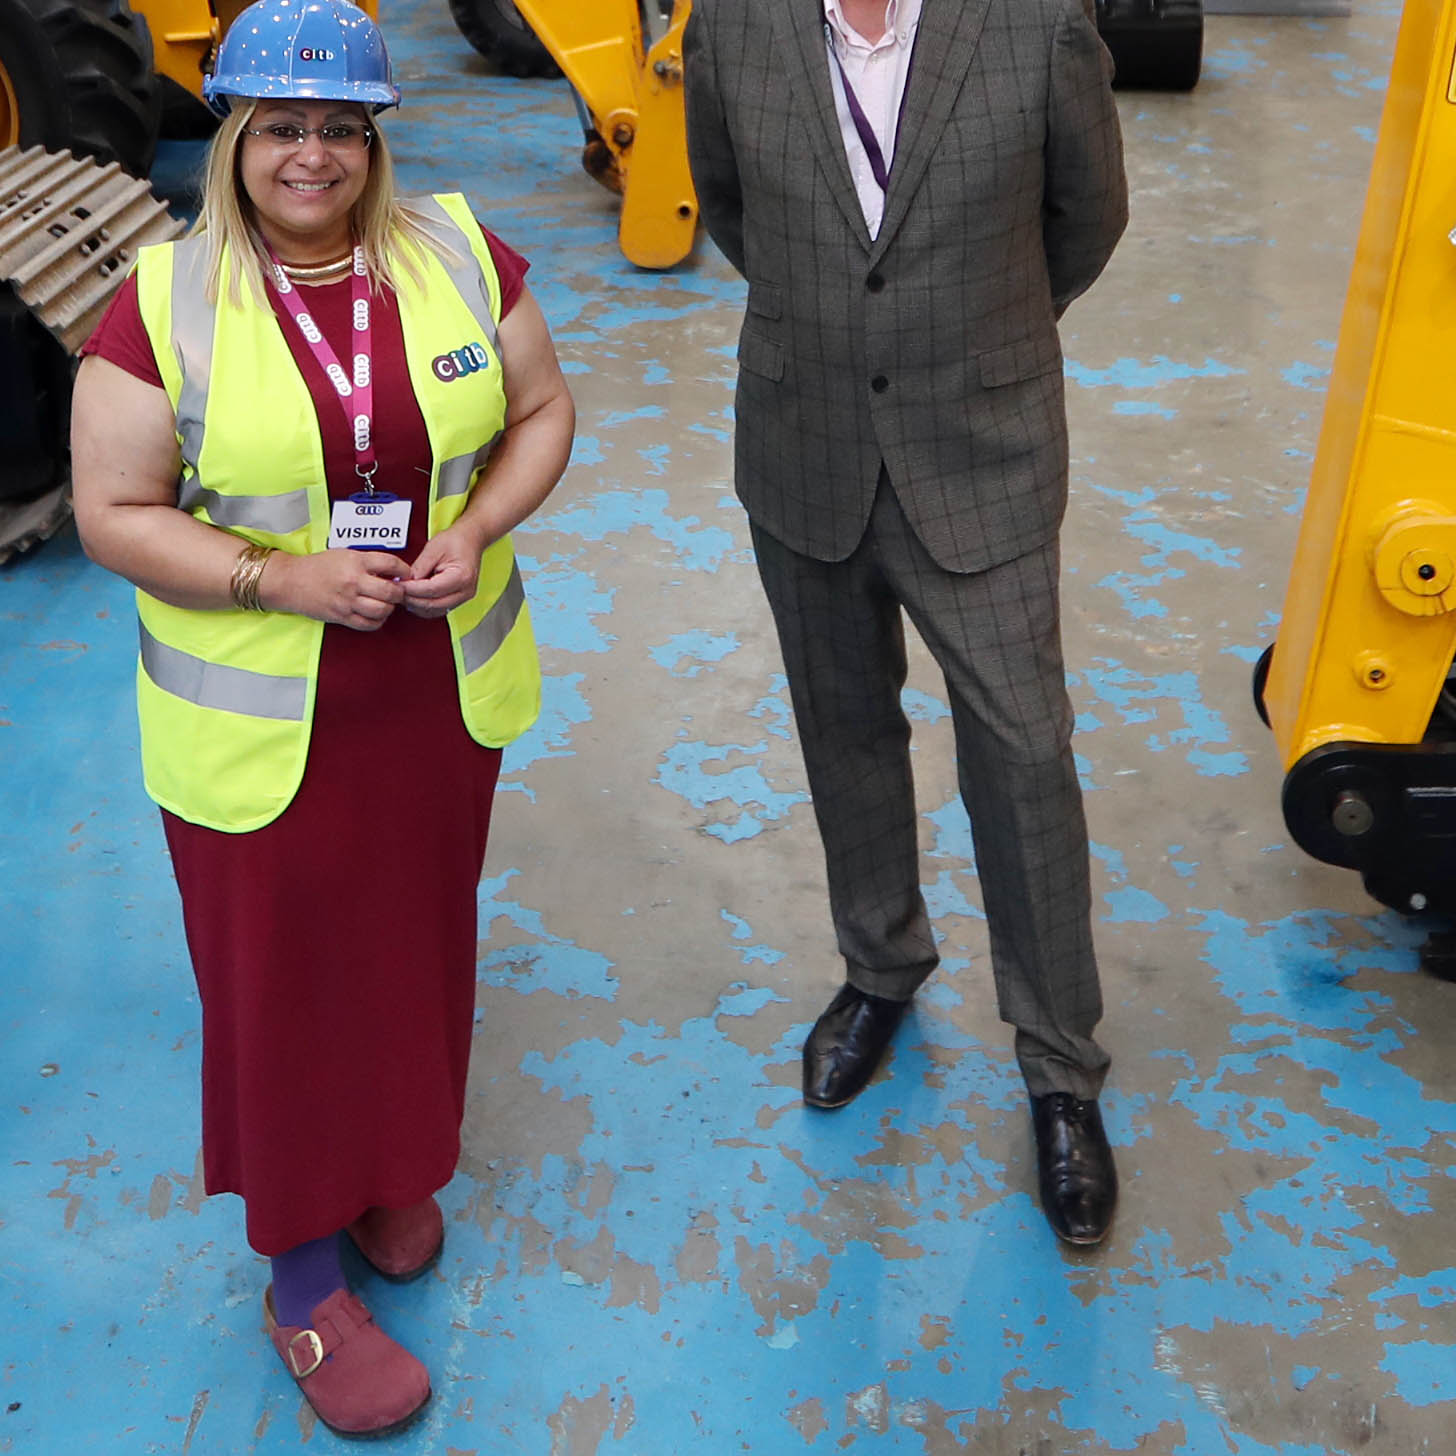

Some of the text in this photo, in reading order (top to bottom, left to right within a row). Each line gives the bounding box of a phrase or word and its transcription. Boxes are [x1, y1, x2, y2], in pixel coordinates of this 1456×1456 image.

[301, 48, 335, 60] citb
[355, 300, 368, 329] citb
[355, 356, 368, 386] citb
[436, 344, 487, 377] citb
[355, 417, 369, 449] citb
[336, 527, 401, 539] VISITOR
